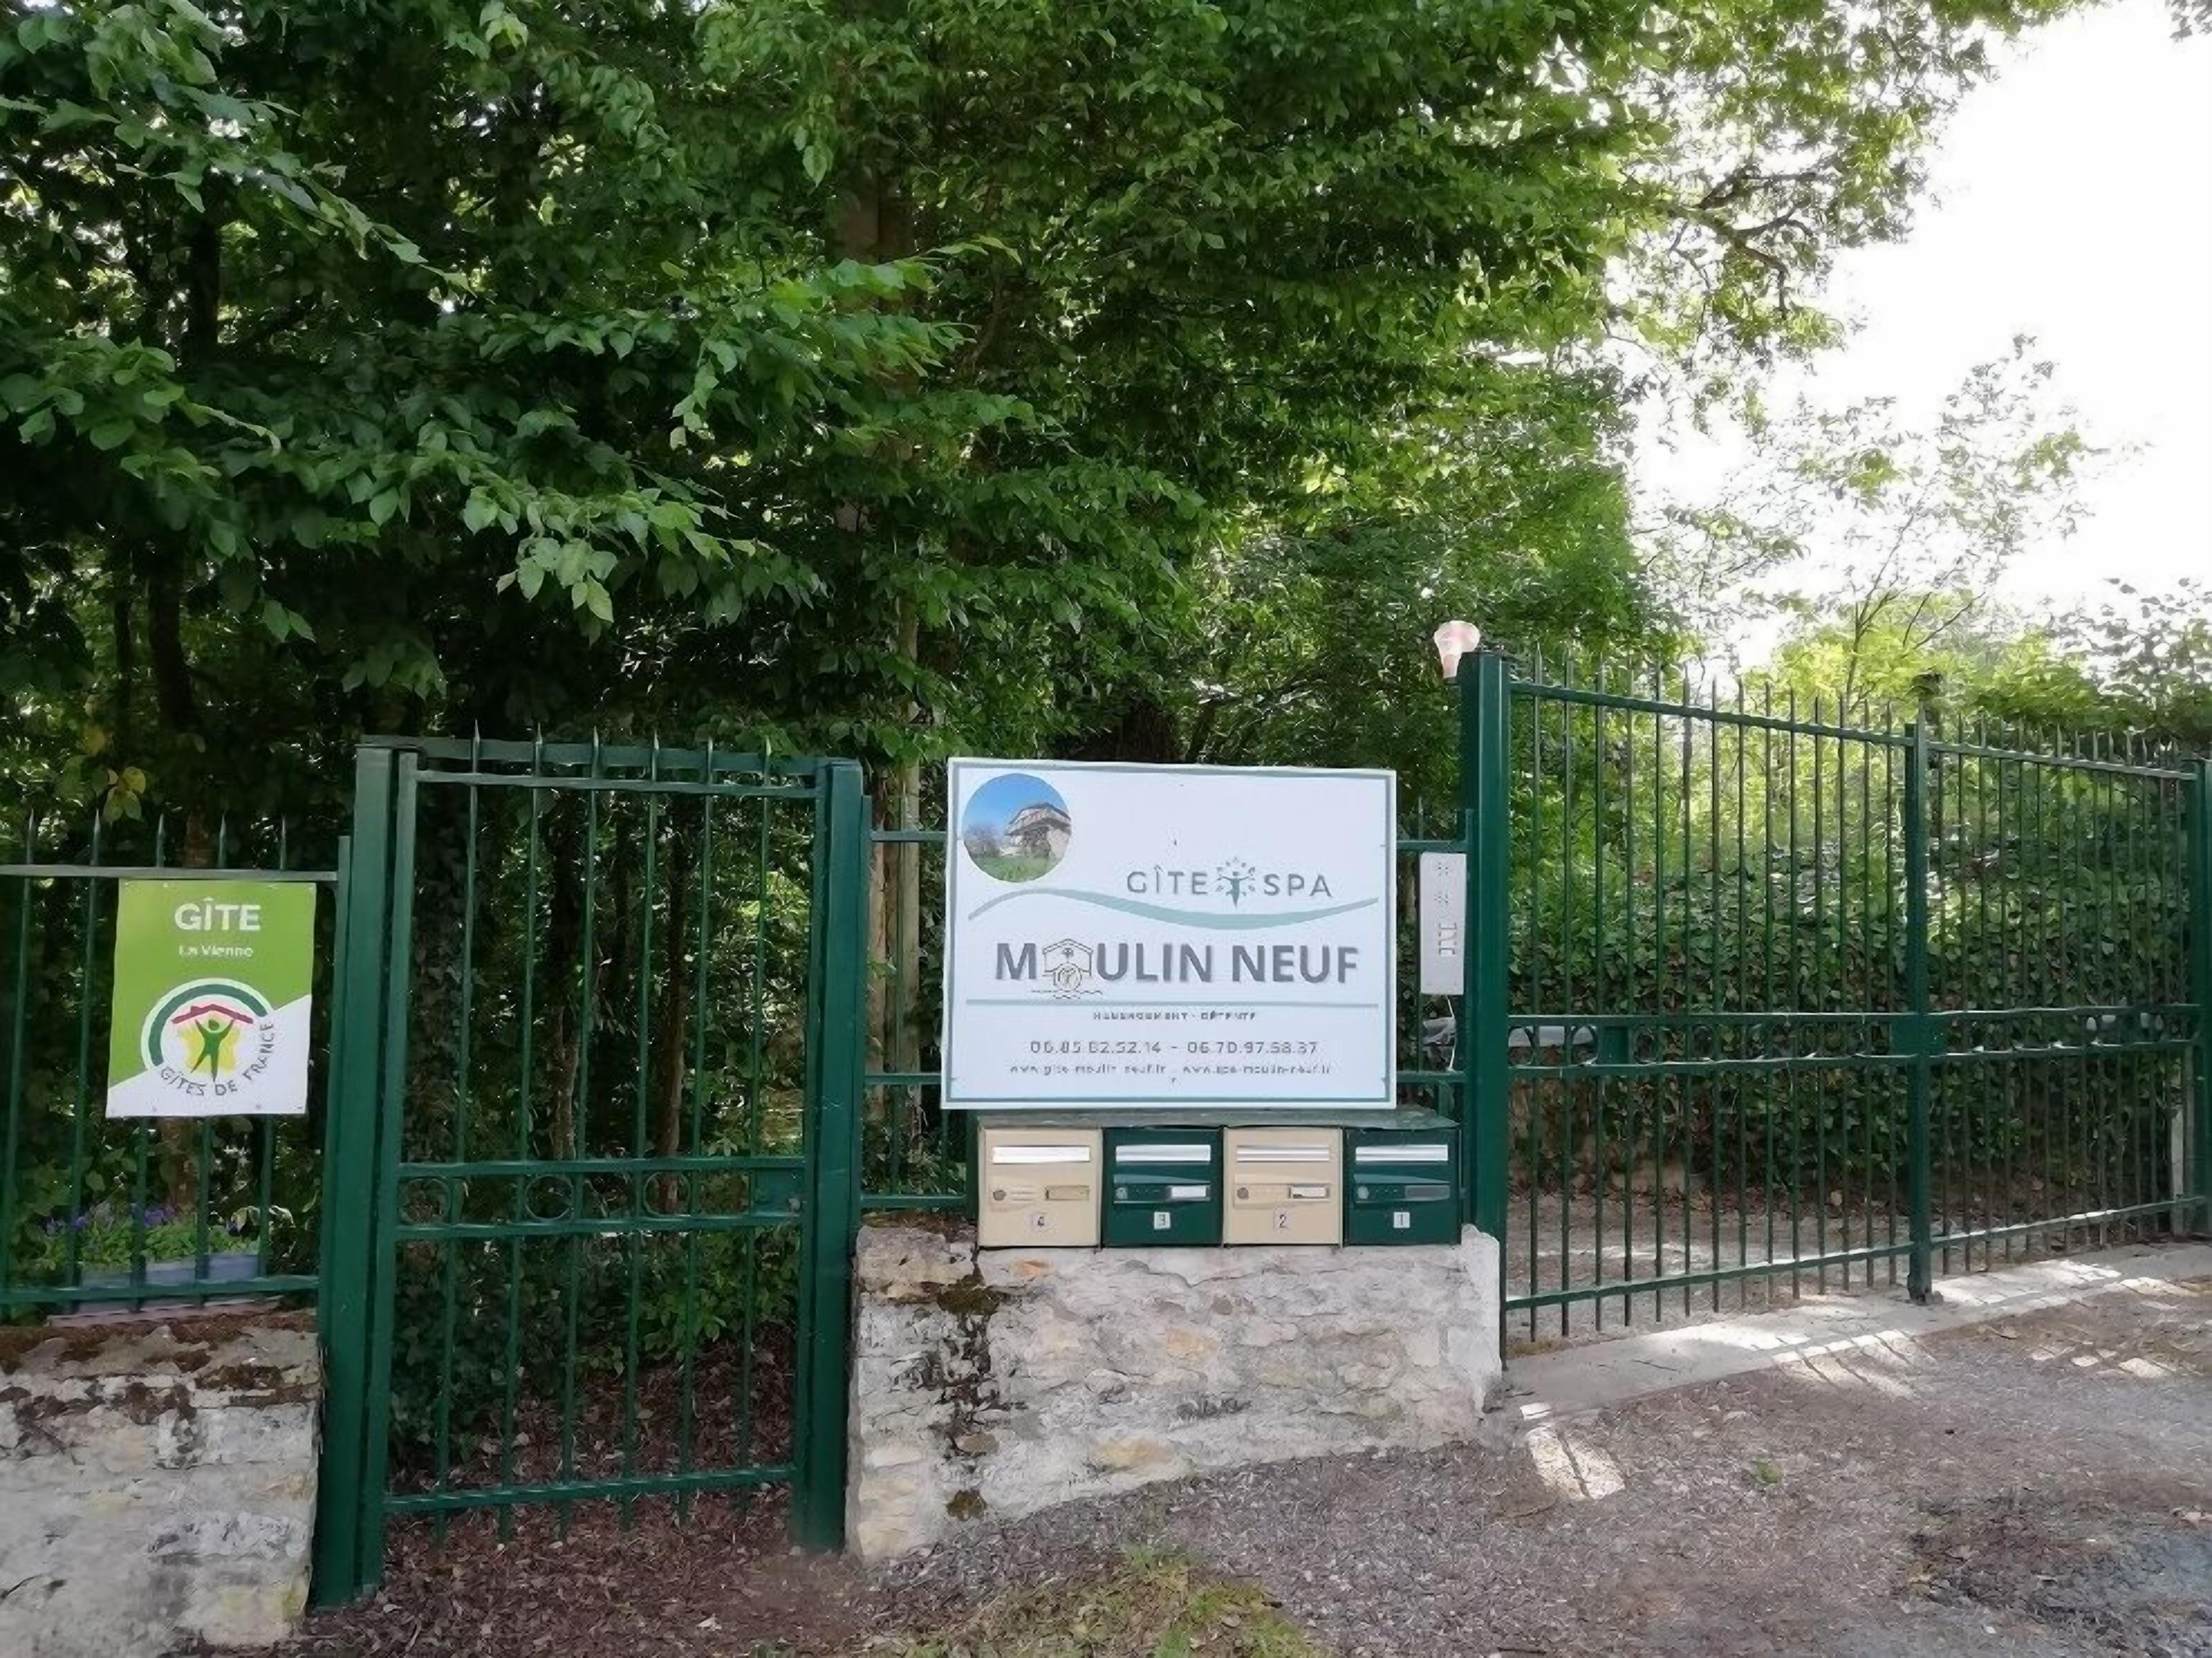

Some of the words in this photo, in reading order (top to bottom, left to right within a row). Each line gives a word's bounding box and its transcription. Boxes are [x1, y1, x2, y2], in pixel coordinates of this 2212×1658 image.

[1126, 865, 1208, 895] GÎTE
[1263, 872, 1333, 898] SPA
[174, 896, 261, 931] GÎTE
[1232, 945, 1359, 984] NEUF
[215, 1079, 238, 1096] DE
[241, 1024, 275, 1081] FRANCE
[1278, 1213, 1288, 1228] 2
